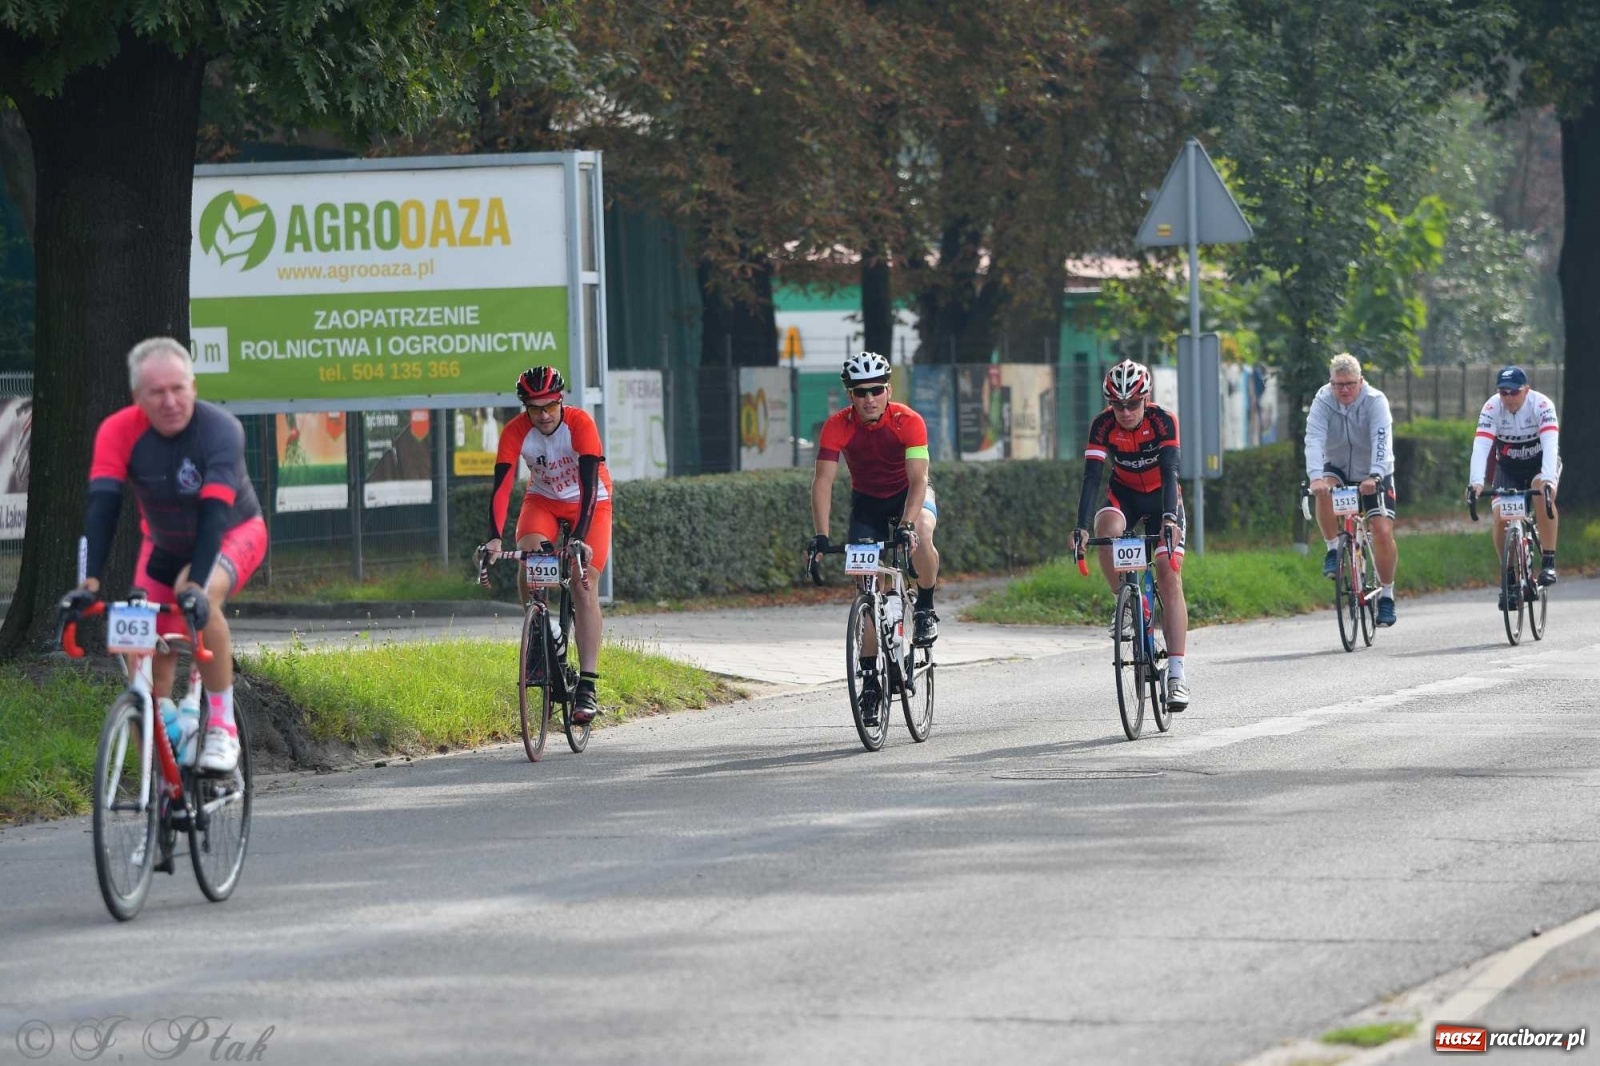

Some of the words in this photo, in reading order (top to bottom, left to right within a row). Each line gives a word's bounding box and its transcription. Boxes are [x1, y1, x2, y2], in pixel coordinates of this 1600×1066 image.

[285, 197, 511, 253] AGROOAZA
[277, 258, 434, 283] www.agrooaza.pl
[314, 305, 480, 331] ZAOPATRZENIE
[204, 343, 221, 362] m
[240, 338, 371, 361] ROLNICTWA
[376, 338, 382, 356] I
[388, 331, 557, 355] OGRODNICTWA
[319, 364, 346, 382] tel.
[352, 363, 385, 381] 504
[391, 362, 422, 380] 135
[428, 361, 461, 379] 366
[1376, 427, 1386, 462] adidas
[1334, 496, 1356, 507] 1515
[1501, 502, 1524, 512] 1514
[851, 553, 875, 564] 110
[1117, 547, 1142, 560] 007
[528, 566, 558, 577] 1910
[115, 619, 150, 636] 063
